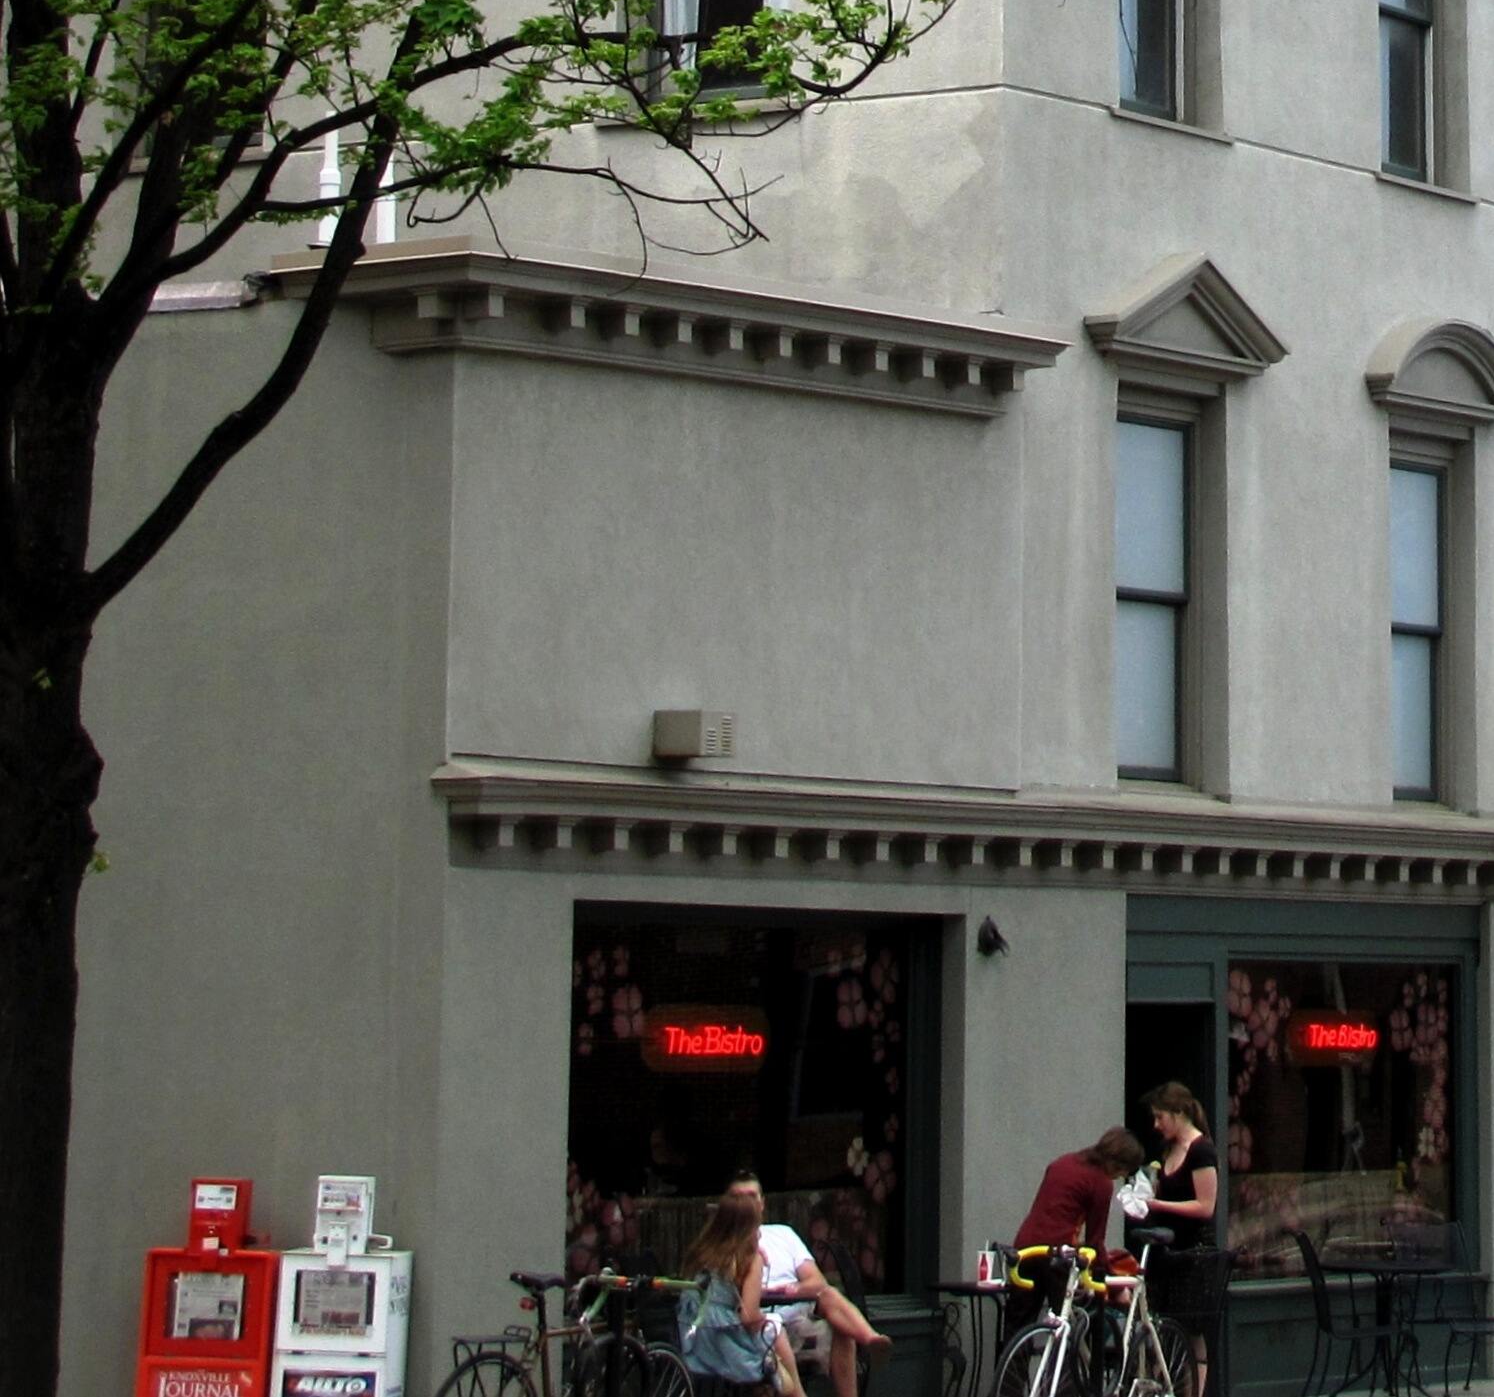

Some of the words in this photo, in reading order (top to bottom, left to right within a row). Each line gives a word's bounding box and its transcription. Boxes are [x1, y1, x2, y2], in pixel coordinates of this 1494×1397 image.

[665, 1026, 703, 1054] The
[704, 1025, 763, 1055] Bistro
[1309, 1024, 1337, 1048] The
[1338, 1023, 1377, 1049] Bistro
[168, 1371, 231, 1383] KNOXVILLE
